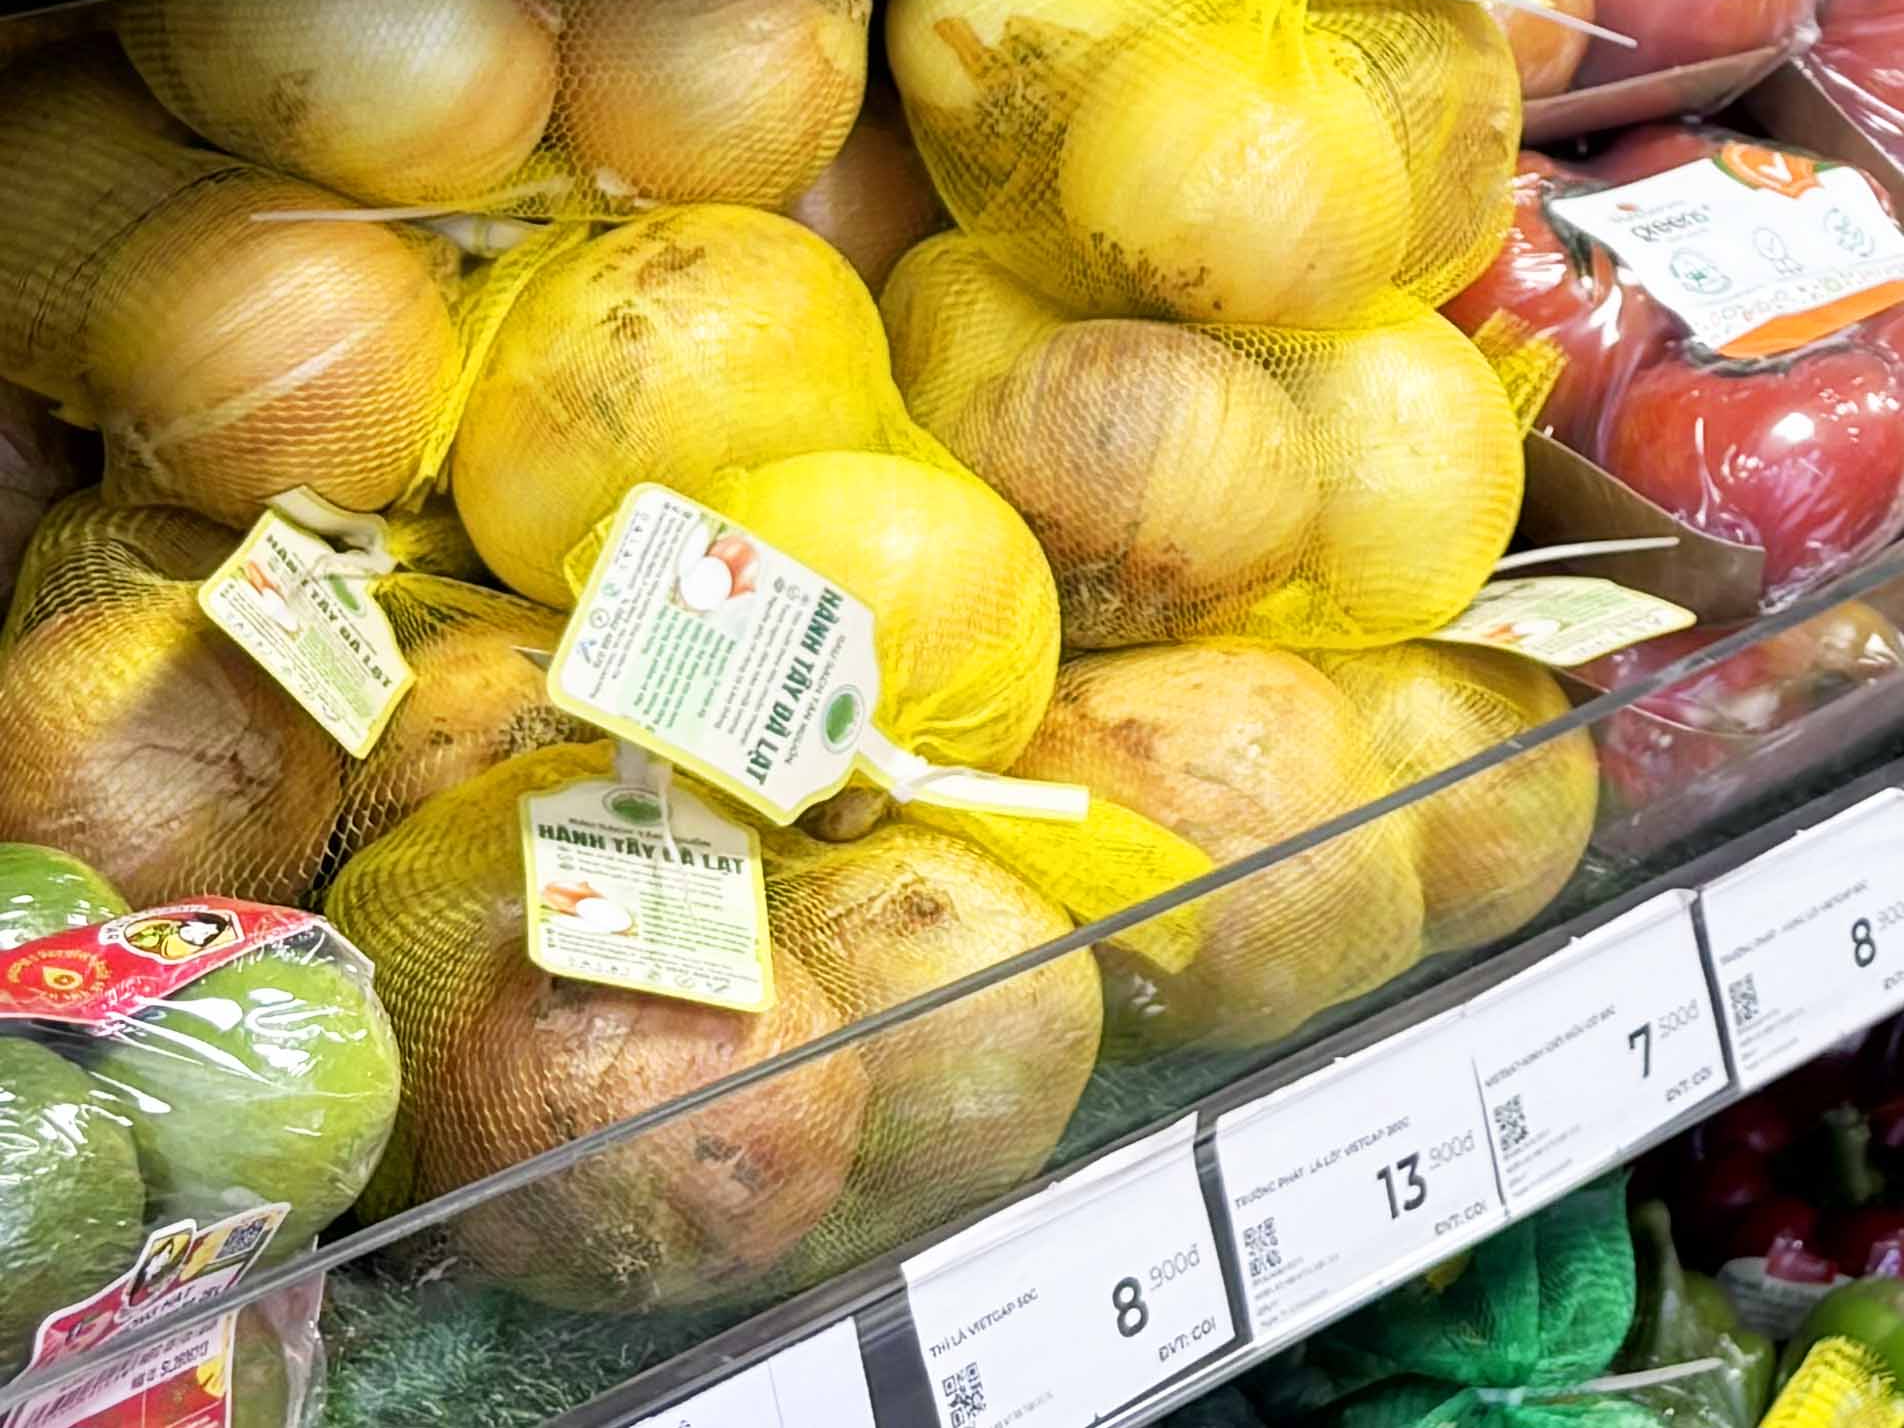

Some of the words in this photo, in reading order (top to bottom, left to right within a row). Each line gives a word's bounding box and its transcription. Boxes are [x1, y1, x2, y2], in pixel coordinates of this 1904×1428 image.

[801, 585, 845, 656] HÀNH
[784, 653, 817, 706] TÂY
[764, 700, 797, 742] ĐÀ
[745, 740, 775, 786] LẠT
[538, 823, 607, 851] HÀNH
[614, 836, 655, 860] TÂY
[703, 854, 746, 877] LẠT
[1850, 916, 1877, 968] 8
[1627, 1021, 1652, 1080] 7
[1376, 1150, 1429, 1222] 13
[1111, 1275, 1150, 1339] 8
